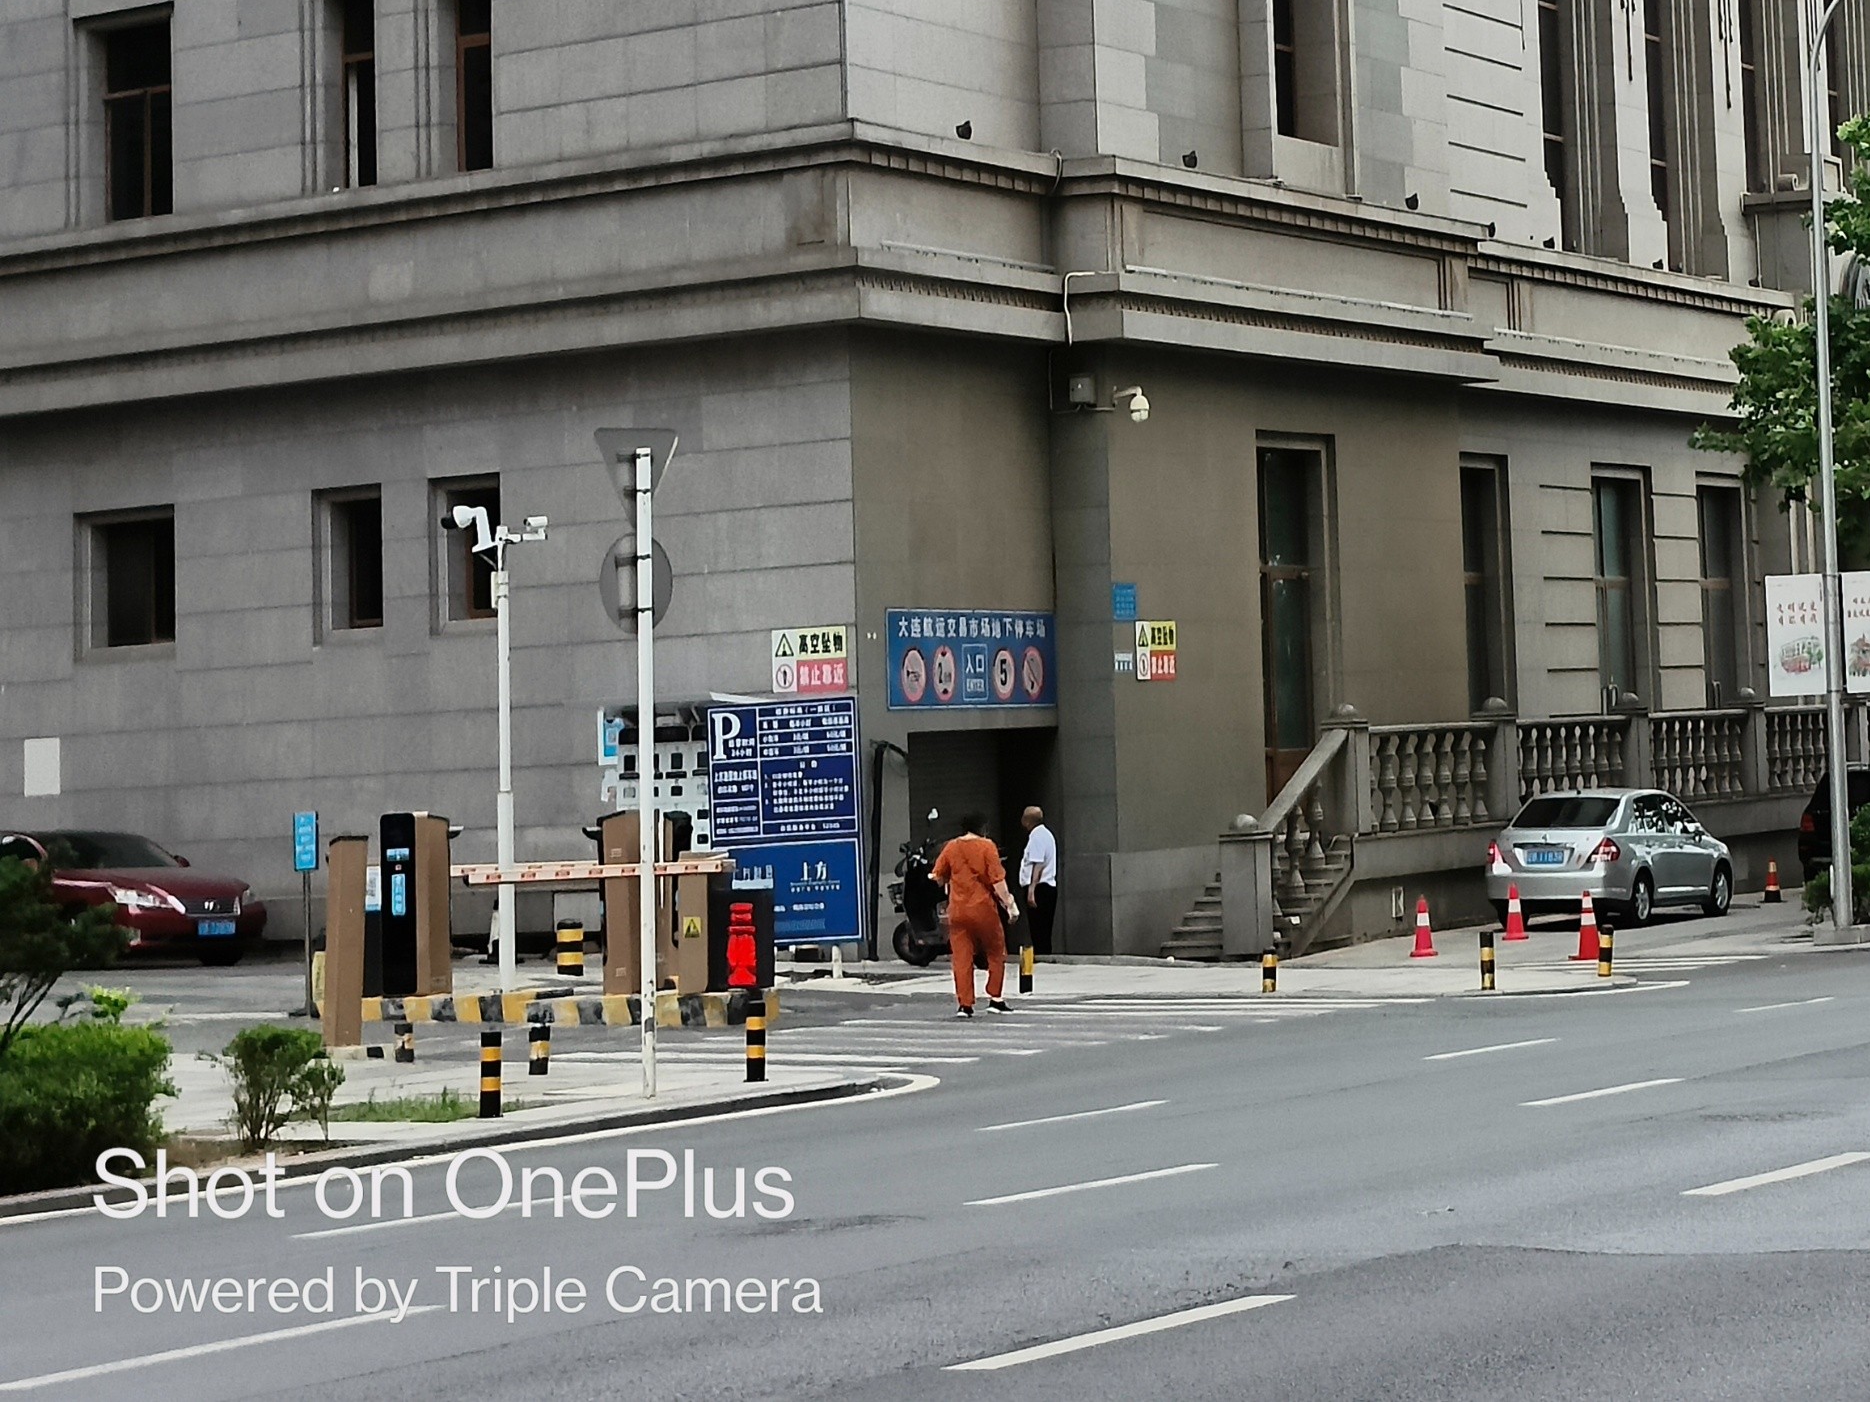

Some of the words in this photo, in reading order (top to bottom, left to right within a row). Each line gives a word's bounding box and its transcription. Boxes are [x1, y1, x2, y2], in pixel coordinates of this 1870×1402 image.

[798, 631, 843, 655] 高空坠物
[965, 653, 985, 674] 入口
[1000, 658, 1008, 686] 5
[711, 712, 741, 761] P
